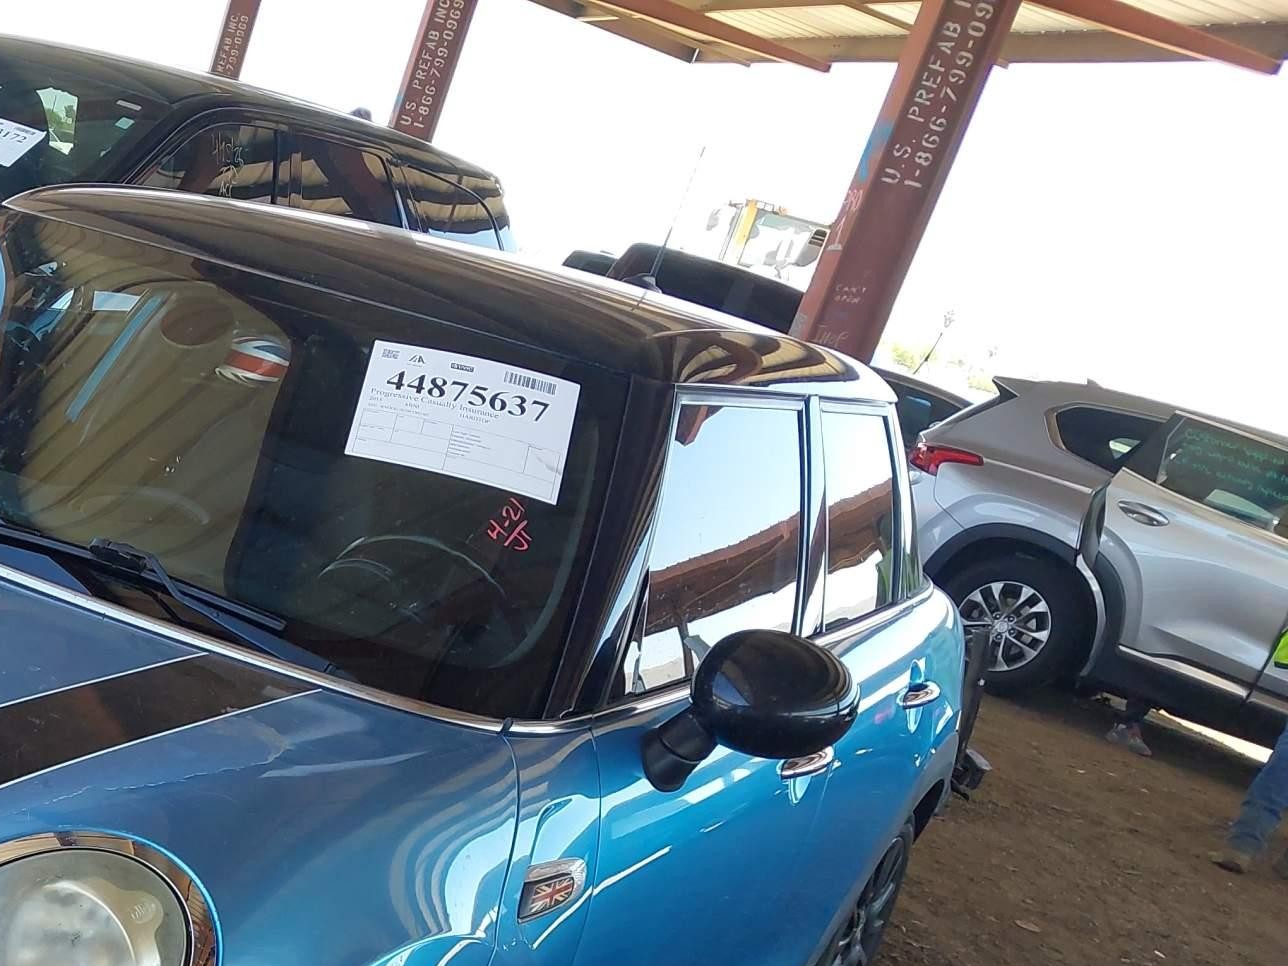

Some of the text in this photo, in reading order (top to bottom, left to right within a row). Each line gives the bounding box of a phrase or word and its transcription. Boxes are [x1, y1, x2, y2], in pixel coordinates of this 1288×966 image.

[412, 30, 440, 89] PREFAB
[907, 20, 962, 122] PREFAB
[370, 387, 420, 402] Progressive
[458, 403, 500, 420] Insurance
[386, 370, 551, 422] 44875637
